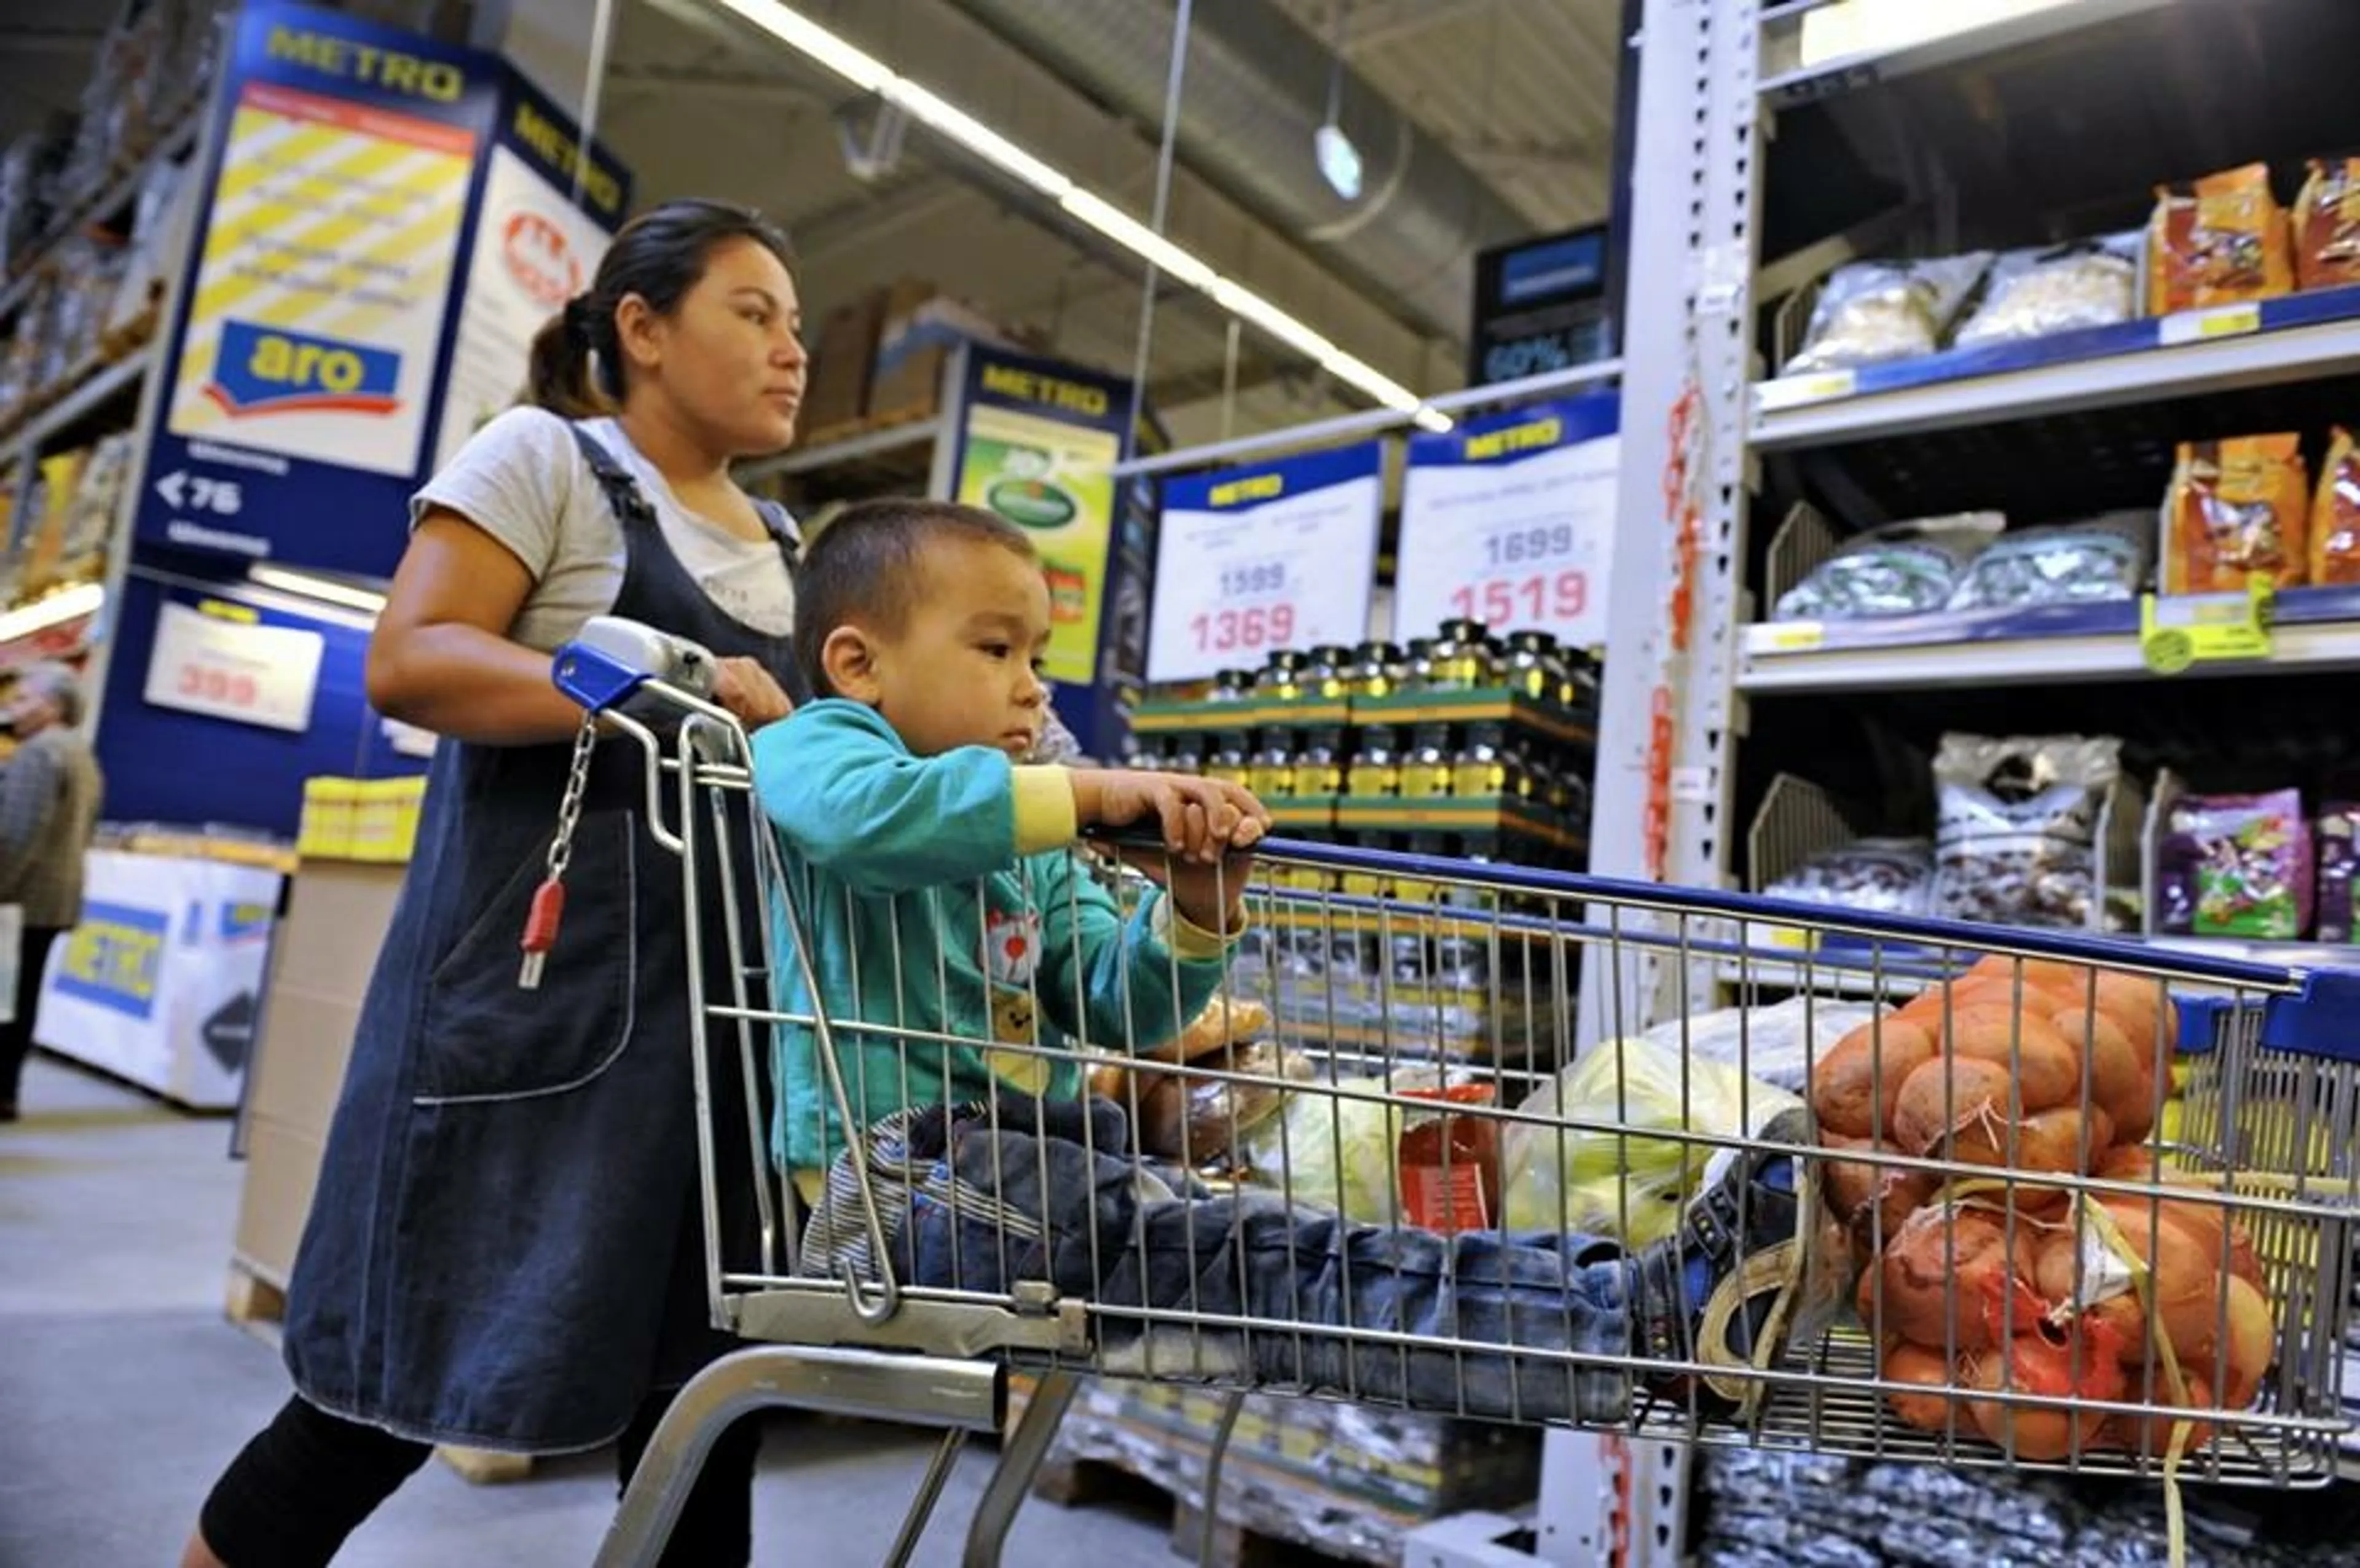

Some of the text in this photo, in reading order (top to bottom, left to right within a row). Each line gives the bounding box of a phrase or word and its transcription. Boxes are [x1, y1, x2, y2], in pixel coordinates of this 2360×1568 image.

[269, 26, 463, 101] METRO
[250, 333, 364, 392] aro
[983, 365, 1108, 416] METRO
[1465, 418, 1562, 460] METRO
[1484, 523, 1573, 564] 1699
[1219, 563, 1286, 597] 1599
[1450, 569, 1588, 628] 1519
[1190, 602, 1296, 652] 1369
